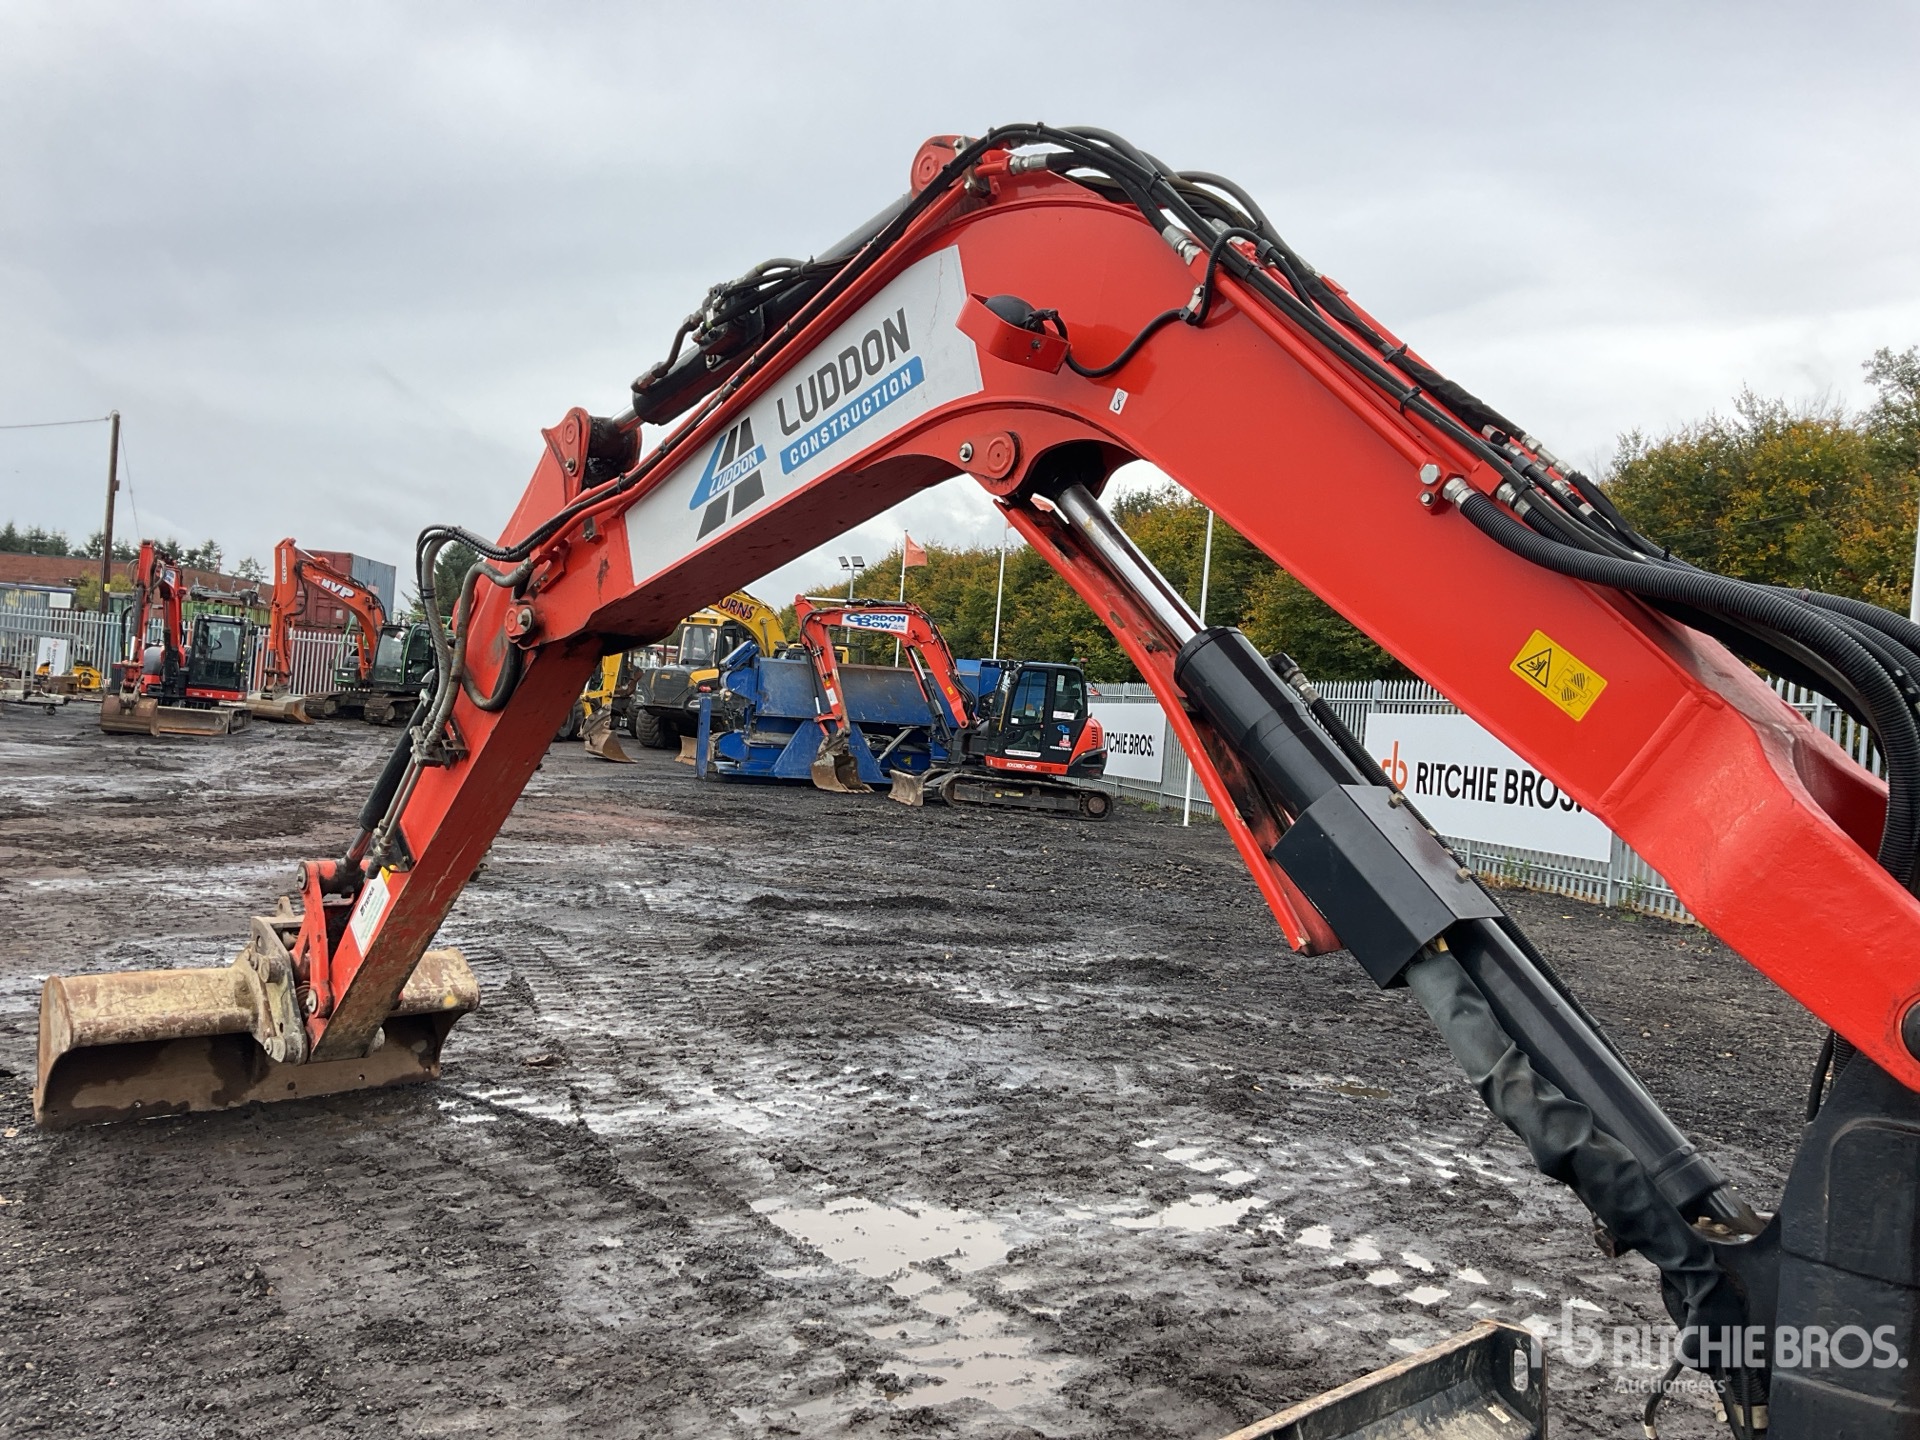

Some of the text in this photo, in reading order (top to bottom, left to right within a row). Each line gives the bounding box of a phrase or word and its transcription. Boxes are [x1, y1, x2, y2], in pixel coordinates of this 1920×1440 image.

[776, 307, 911, 437] LUDDON
[789, 368, 912, 466] CONSTRUCTION
[708, 450, 758, 497] LUDDON
[718, 597, 755, 620] URNS
[846, 613, 906, 623] GORDON
[857, 617, 891, 629] BOW
[1104, 732, 1154, 757] ITCHIE BROS.
[1416, 762, 1498, 803] RITCHIE
